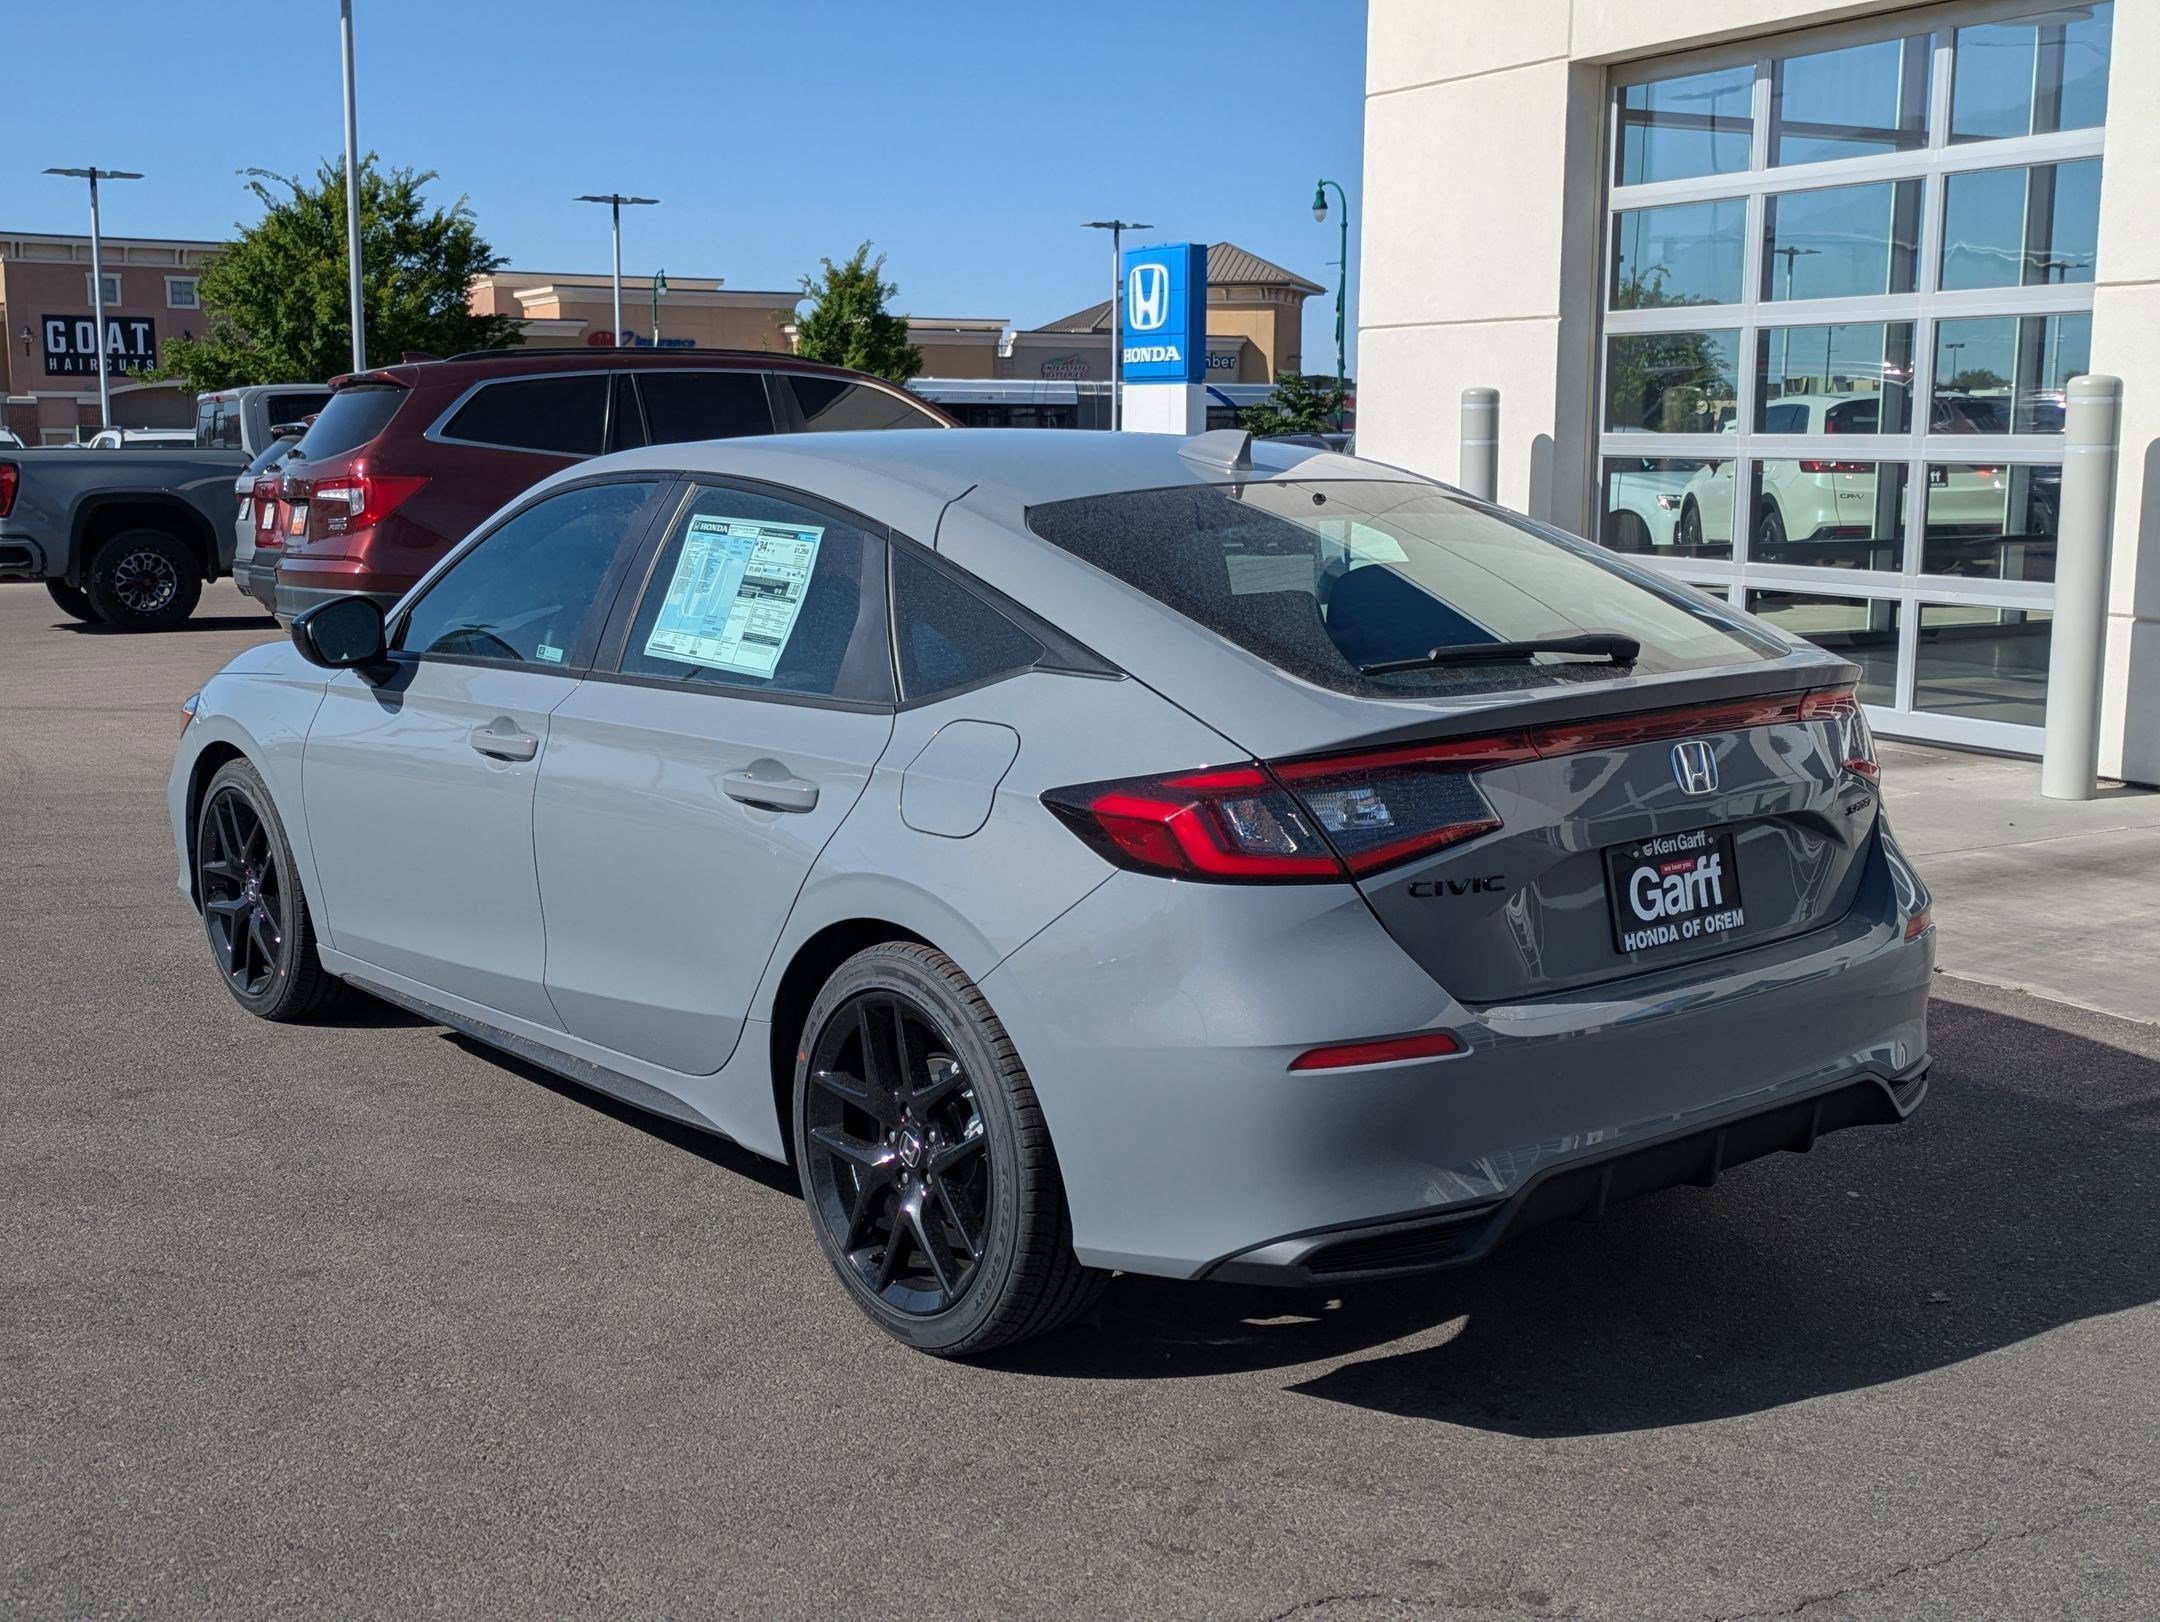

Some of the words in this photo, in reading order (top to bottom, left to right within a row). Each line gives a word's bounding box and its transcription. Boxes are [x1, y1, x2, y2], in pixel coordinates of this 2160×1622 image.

[46, 321, 153, 355] G.O.A.T.
[49, 357, 155, 372] HAIRCUTS
[1123, 346, 1182, 364] HONDA
[700, 522, 728, 533] HONDA
[1653, 838, 1677, 856] Ken
[1677, 830, 1706, 853] Garff
[1408, 875, 1506, 898] CIVIC
[1629, 853, 1723, 921] Garff
[1624, 924, 1680, 952] HONDA
[1682, 919, 1701, 939] OF
[1704, 909, 1745, 934] OREM
